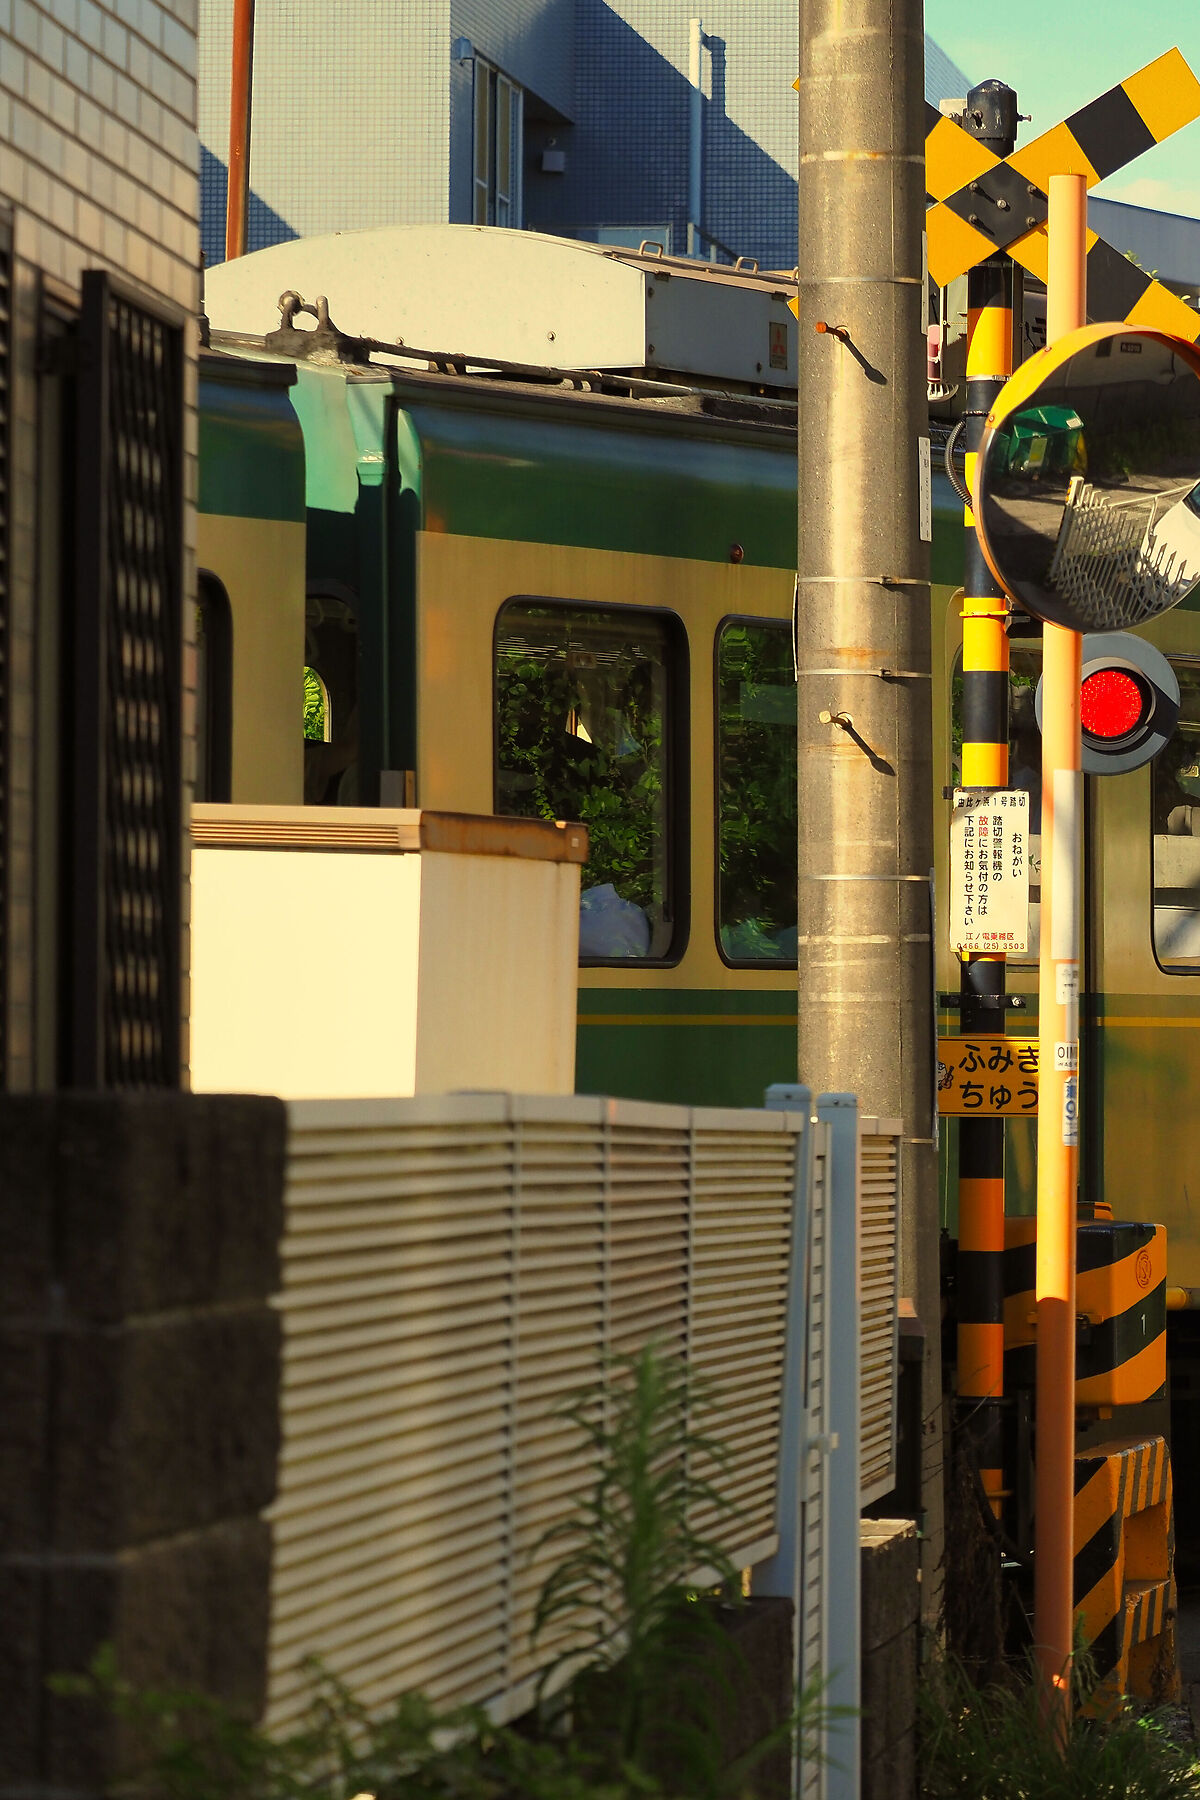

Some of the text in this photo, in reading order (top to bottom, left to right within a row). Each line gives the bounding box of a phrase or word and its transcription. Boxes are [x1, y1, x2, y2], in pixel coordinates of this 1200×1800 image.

[964, 815, 975, 926] 下記にお知らせ下さい
[978, 815, 989, 916] 故障にお気付の方は
[992, 815, 1003, 882] 踏切警報機の
[1012, 832, 1023, 878] おねがい
[1003, 942, 1025, 950] 3503
[1140, 1313, 1146, 1336] 1
